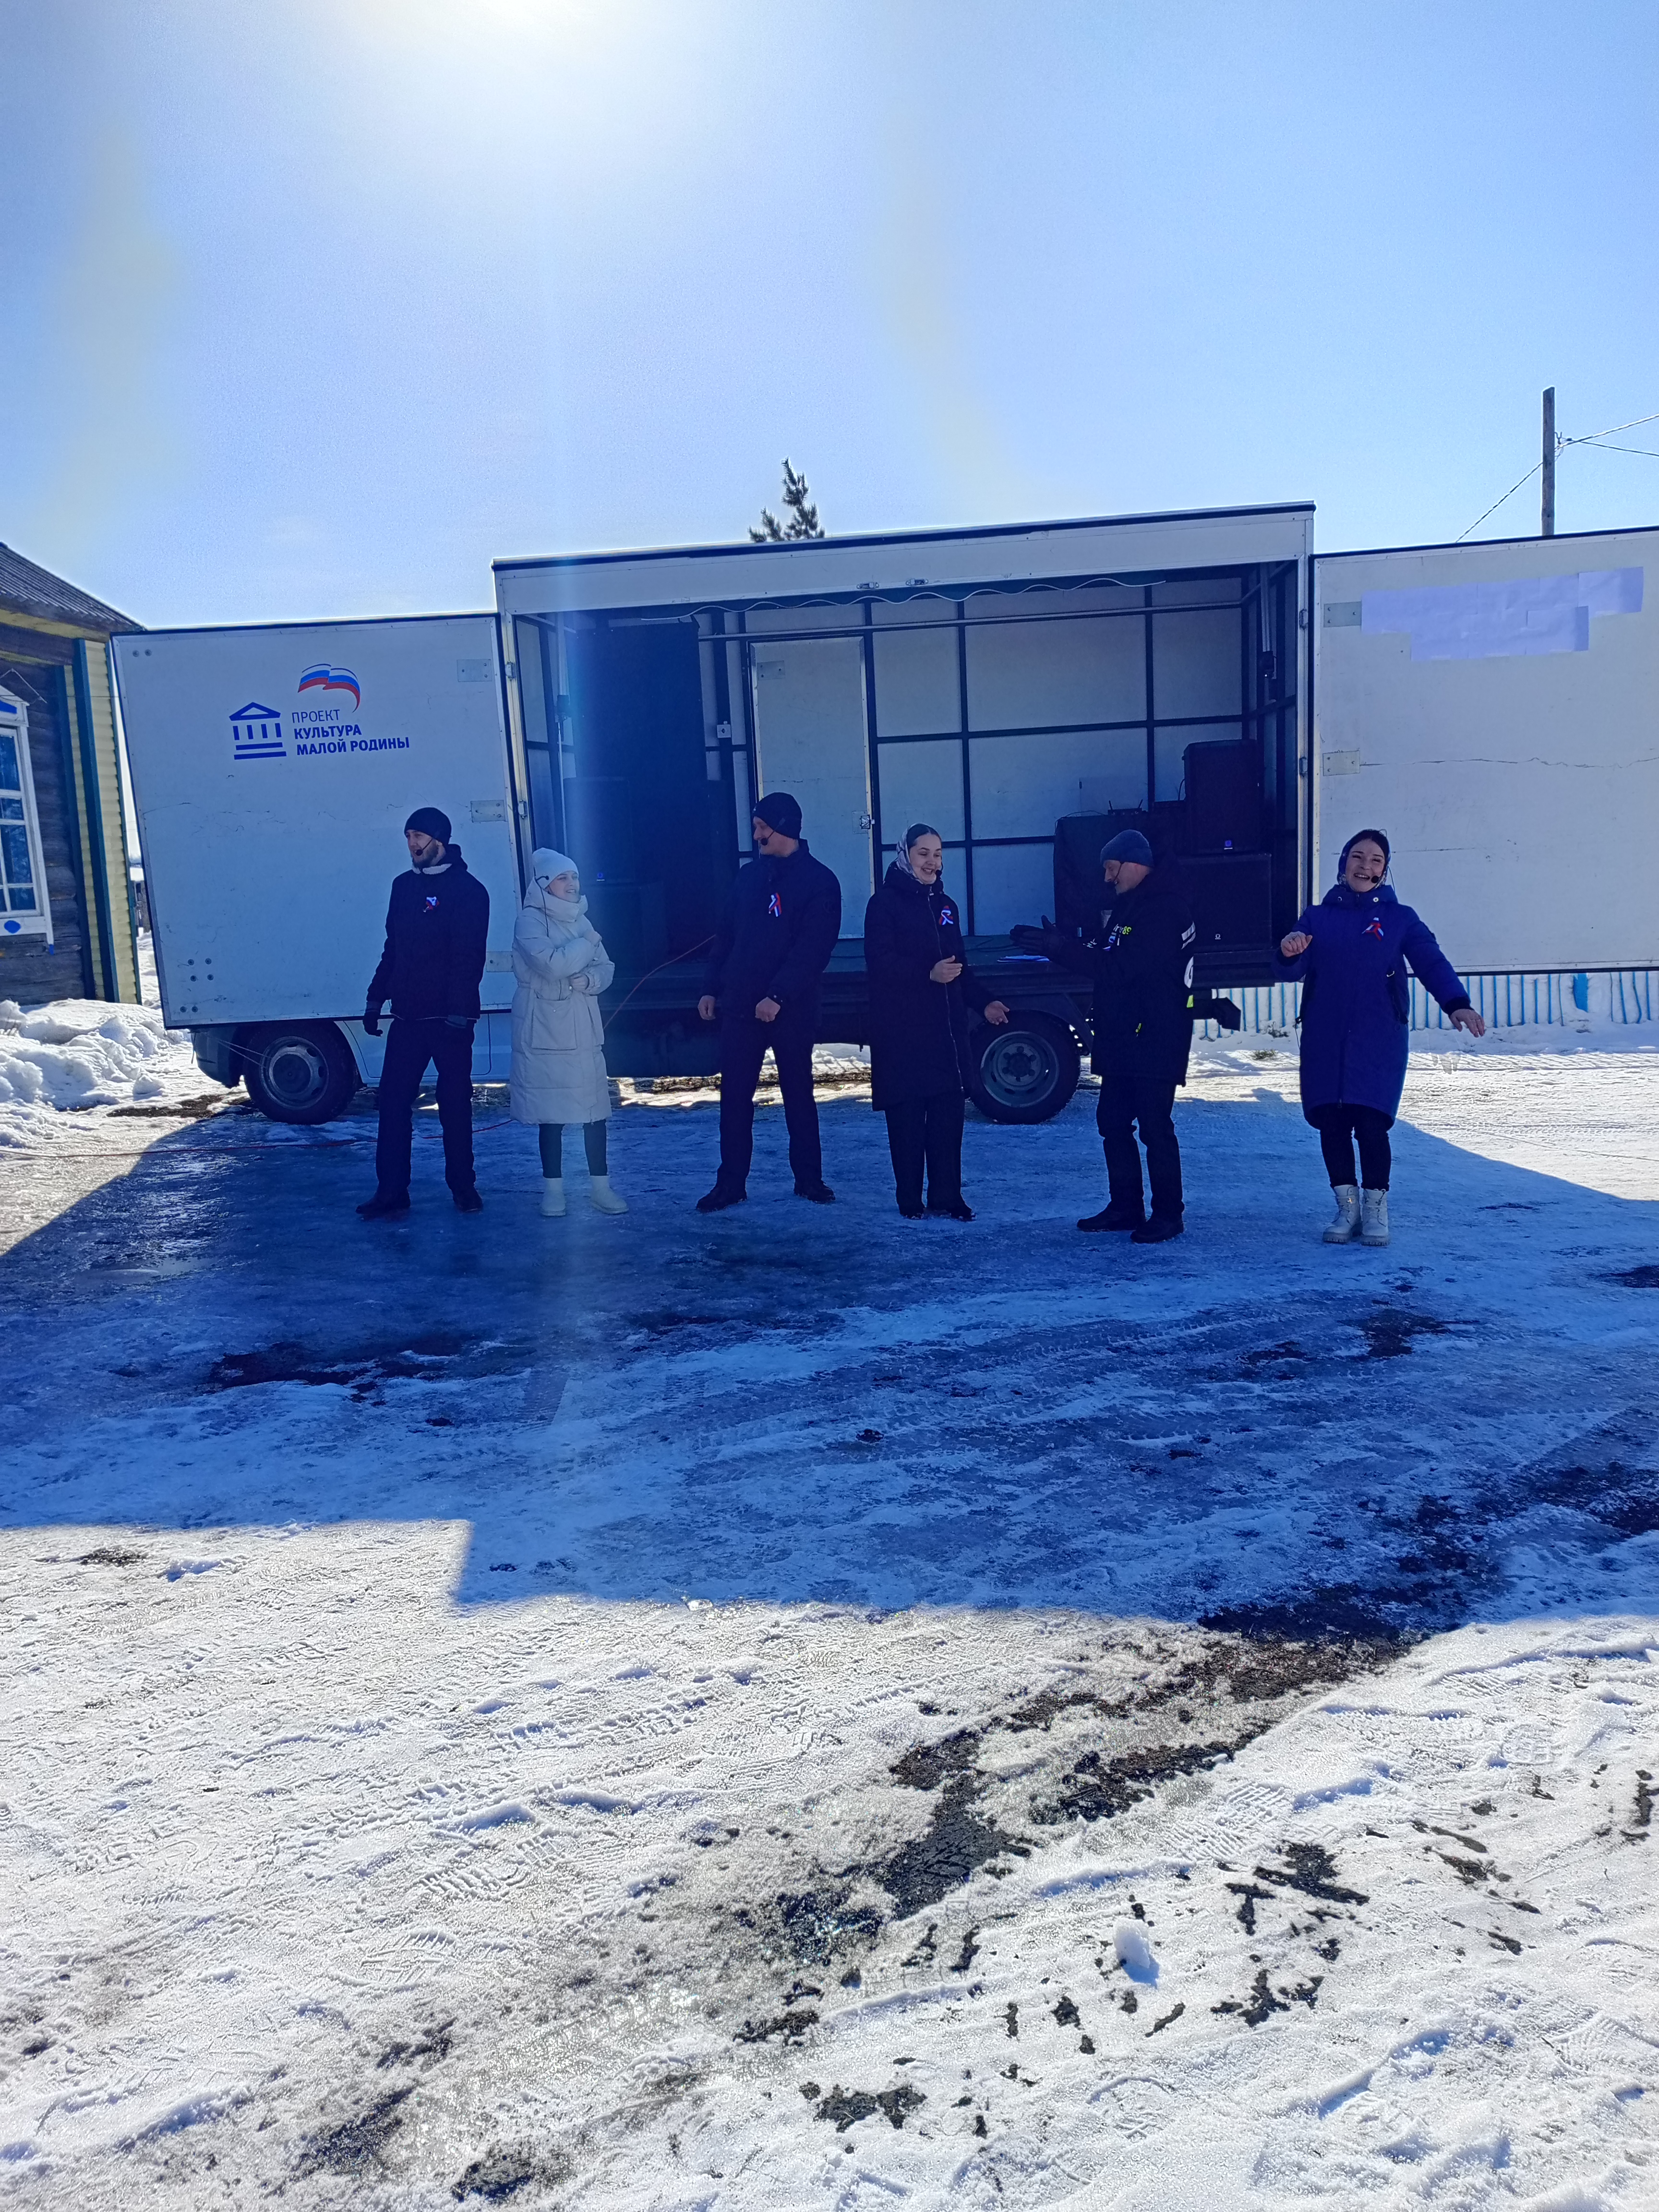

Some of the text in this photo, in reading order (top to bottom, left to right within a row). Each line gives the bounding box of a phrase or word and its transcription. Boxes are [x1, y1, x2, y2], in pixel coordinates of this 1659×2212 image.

[292, 709, 340, 723] ПРОЕКТ
[294, 724, 361, 739] КУЛЬТУРА
[297, 737, 409, 755] МАЛОЙ РОДИНЫ
